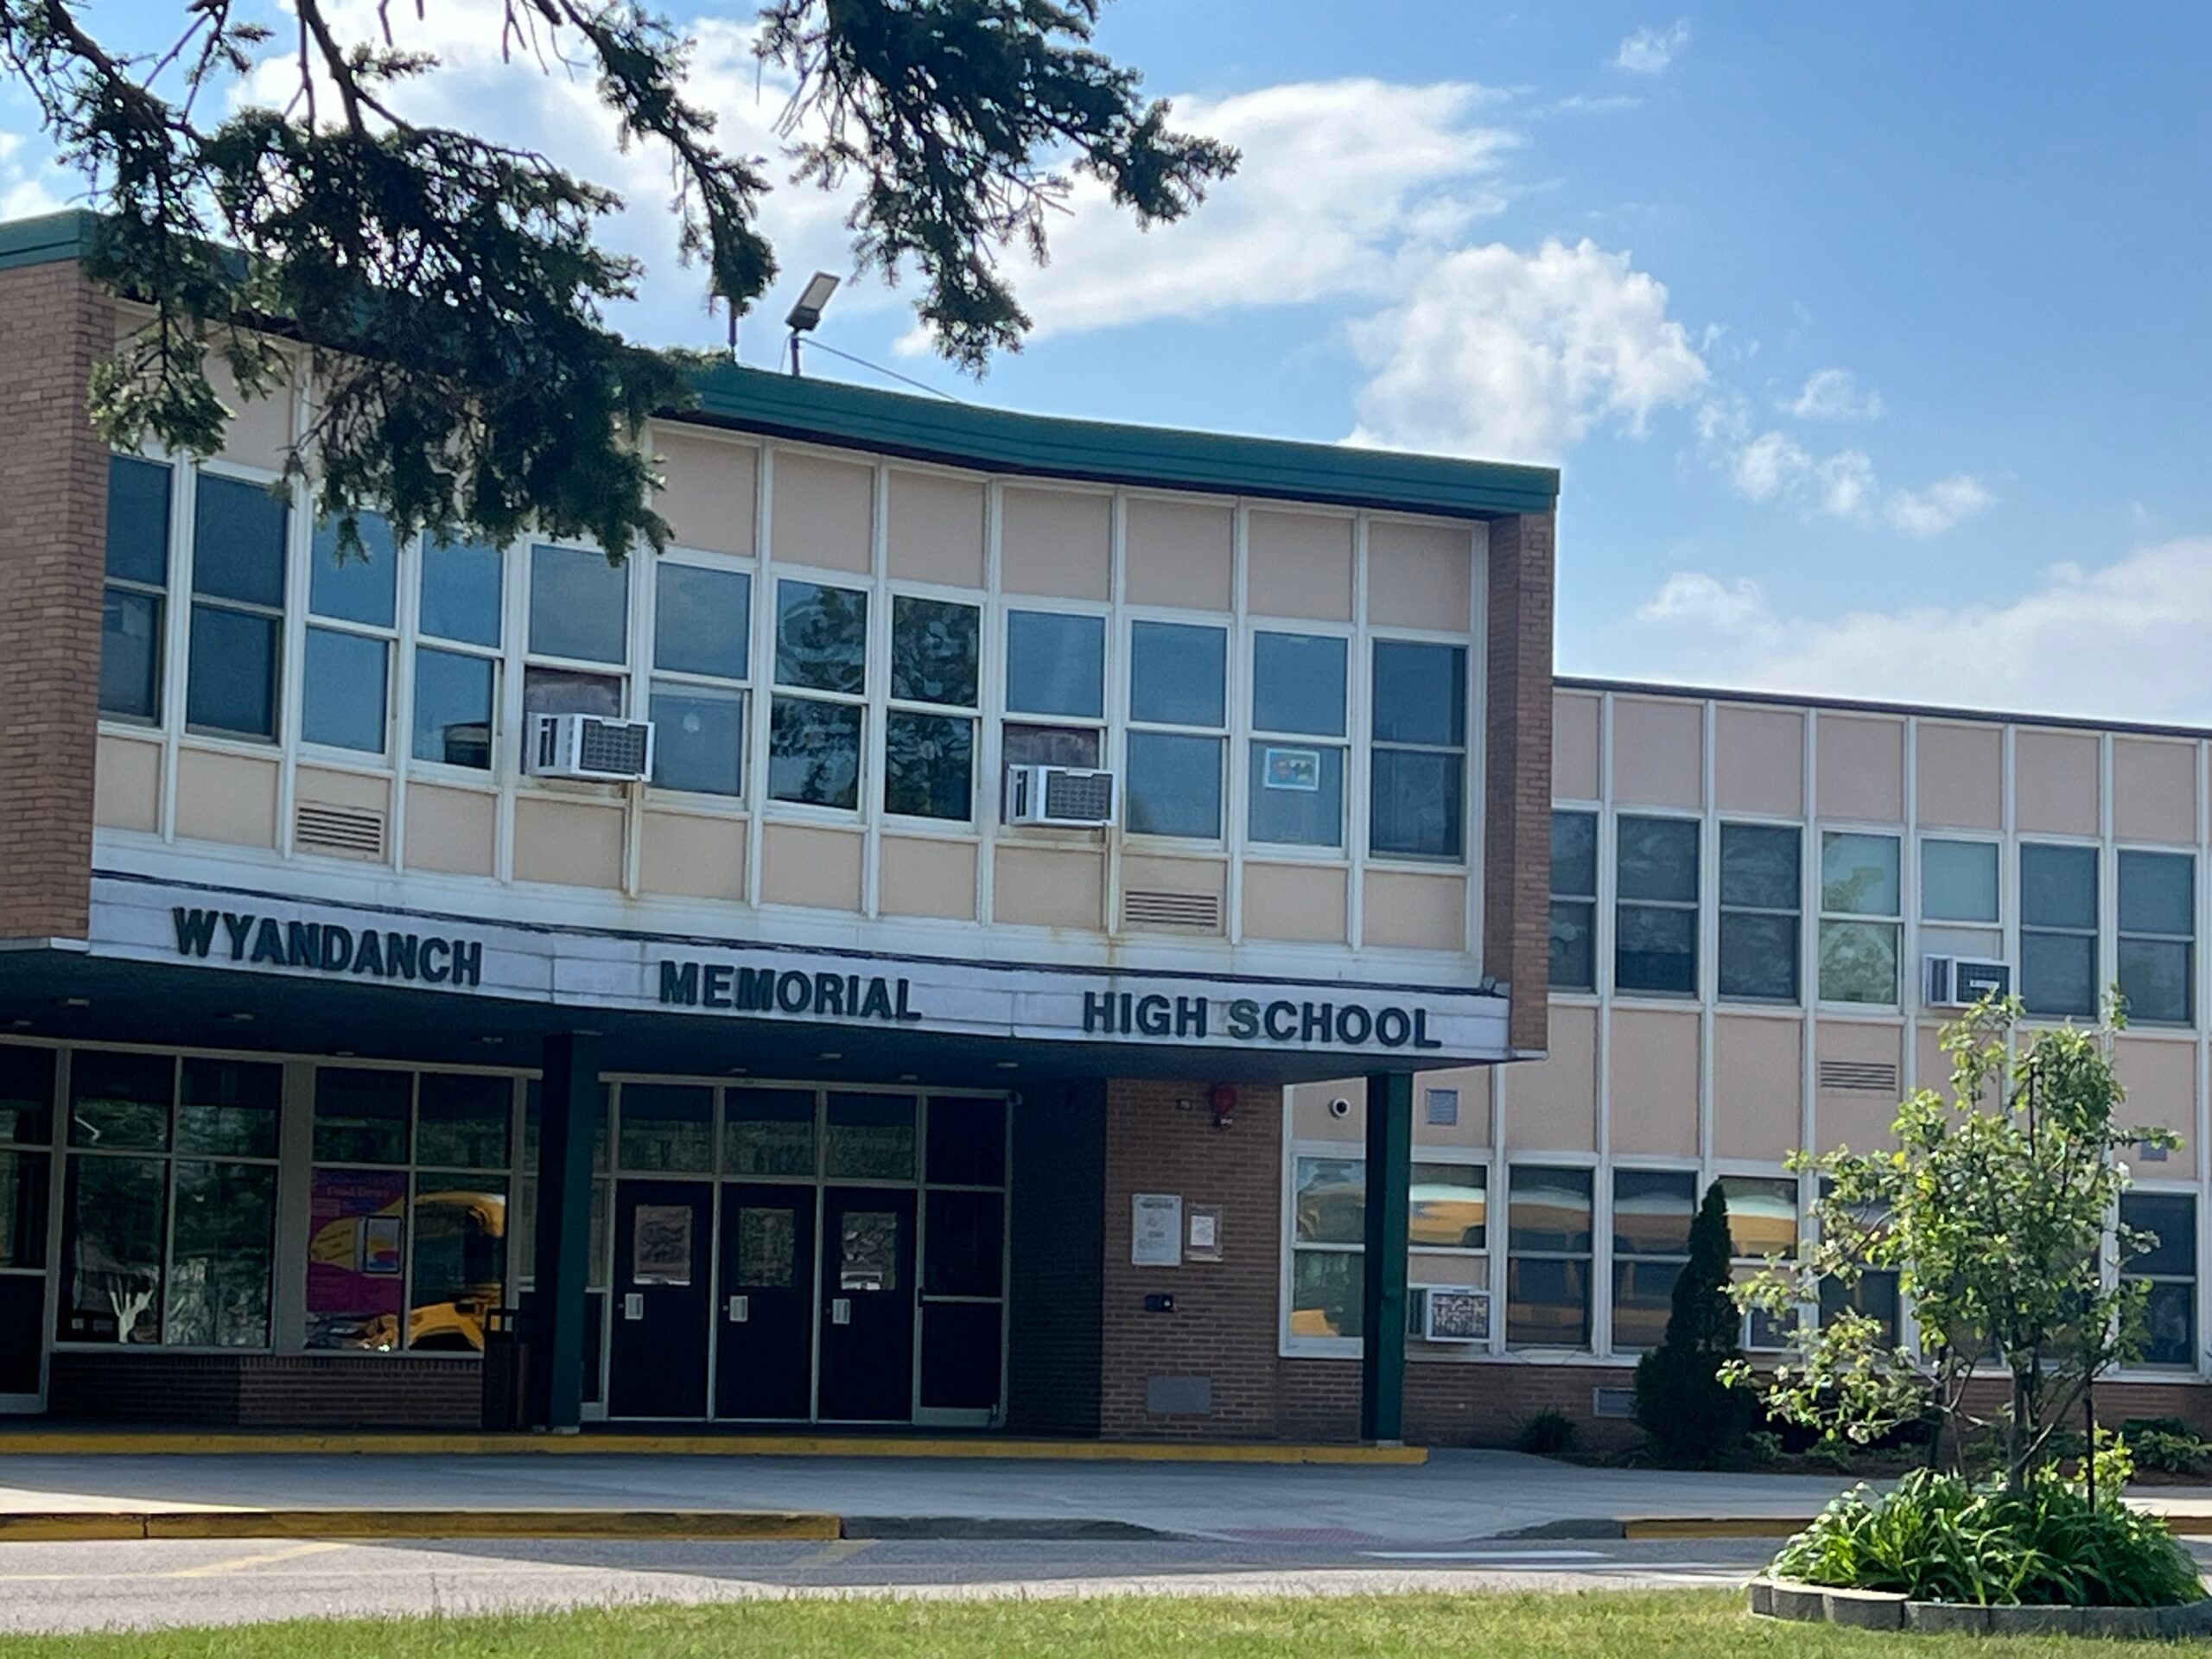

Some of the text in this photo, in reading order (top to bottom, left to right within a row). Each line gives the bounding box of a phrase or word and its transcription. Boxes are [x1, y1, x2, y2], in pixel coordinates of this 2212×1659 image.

[173, 906, 1443, 1049] WYANDANCH MEMORIAL HIGH SCHOOL
